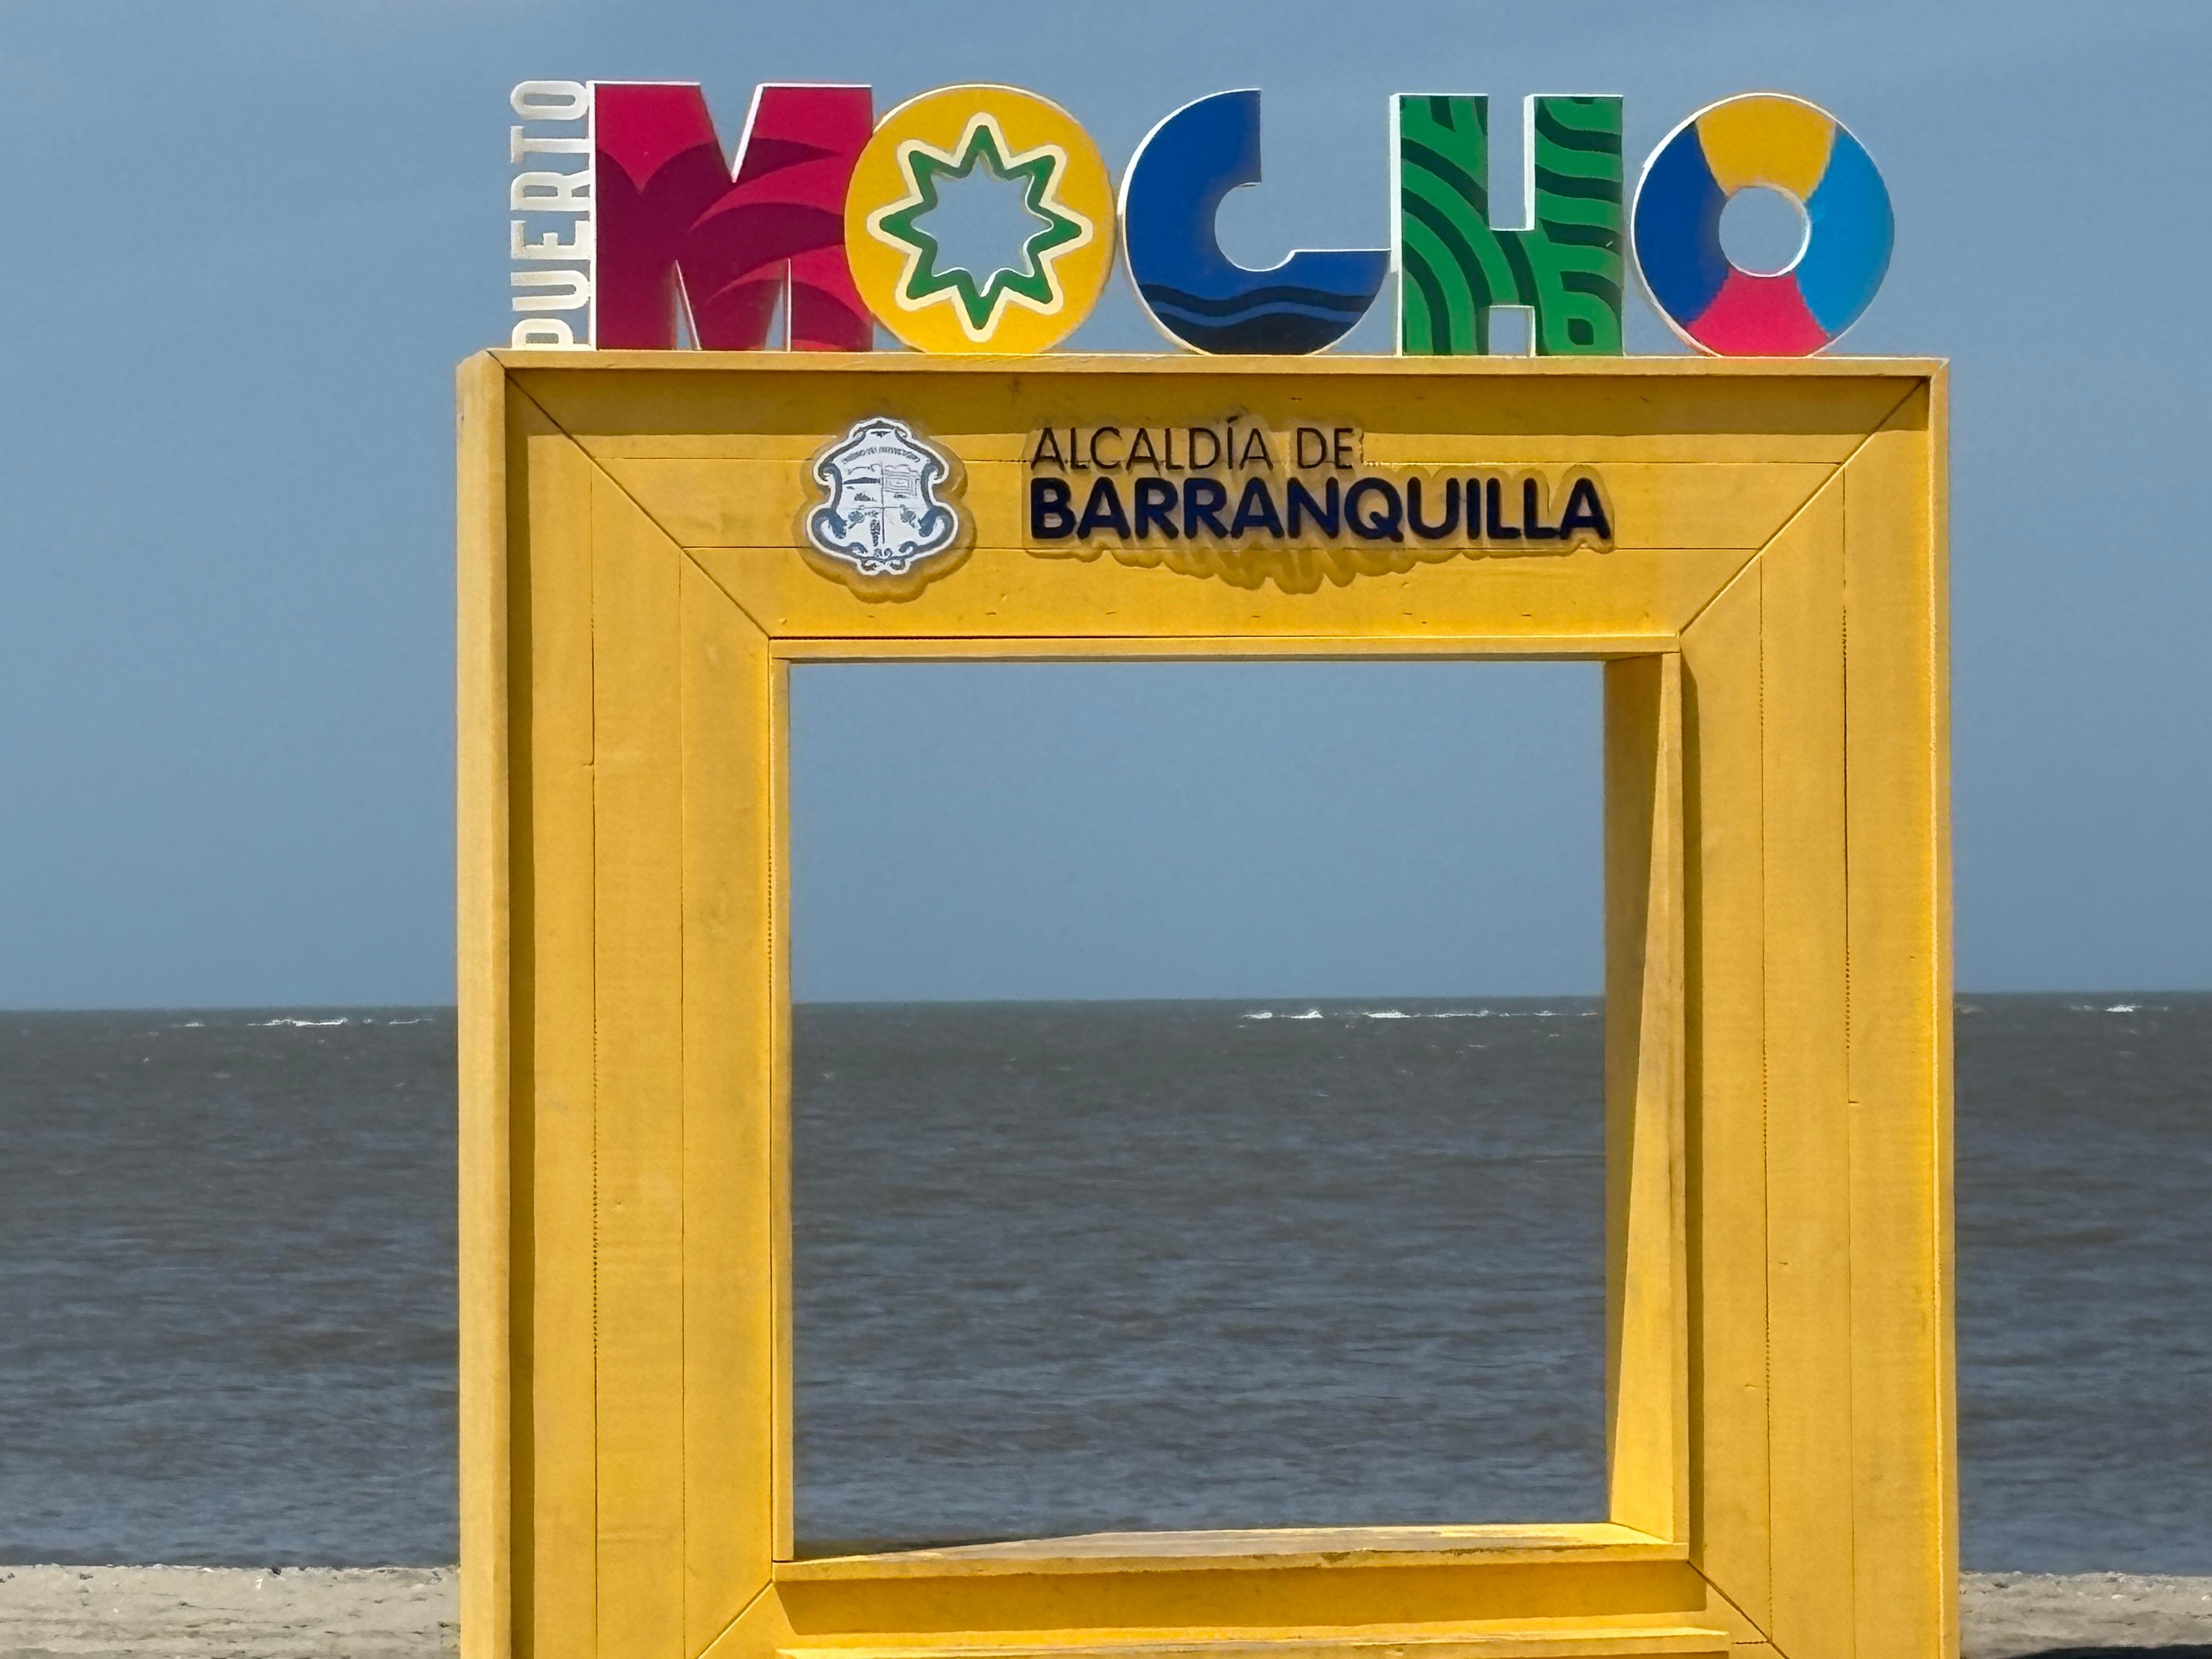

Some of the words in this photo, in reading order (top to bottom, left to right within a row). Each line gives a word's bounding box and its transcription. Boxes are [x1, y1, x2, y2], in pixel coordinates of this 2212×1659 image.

[510, 80, 591, 351] PUERTO
[591, 81, 1894, 358] MOCHO
[1030, 476, 1611, 543] BARRANQUILLA
[1031, 415, 1273, 471] ALCALDÍA
[1296, 427, 1354, 470] DE
